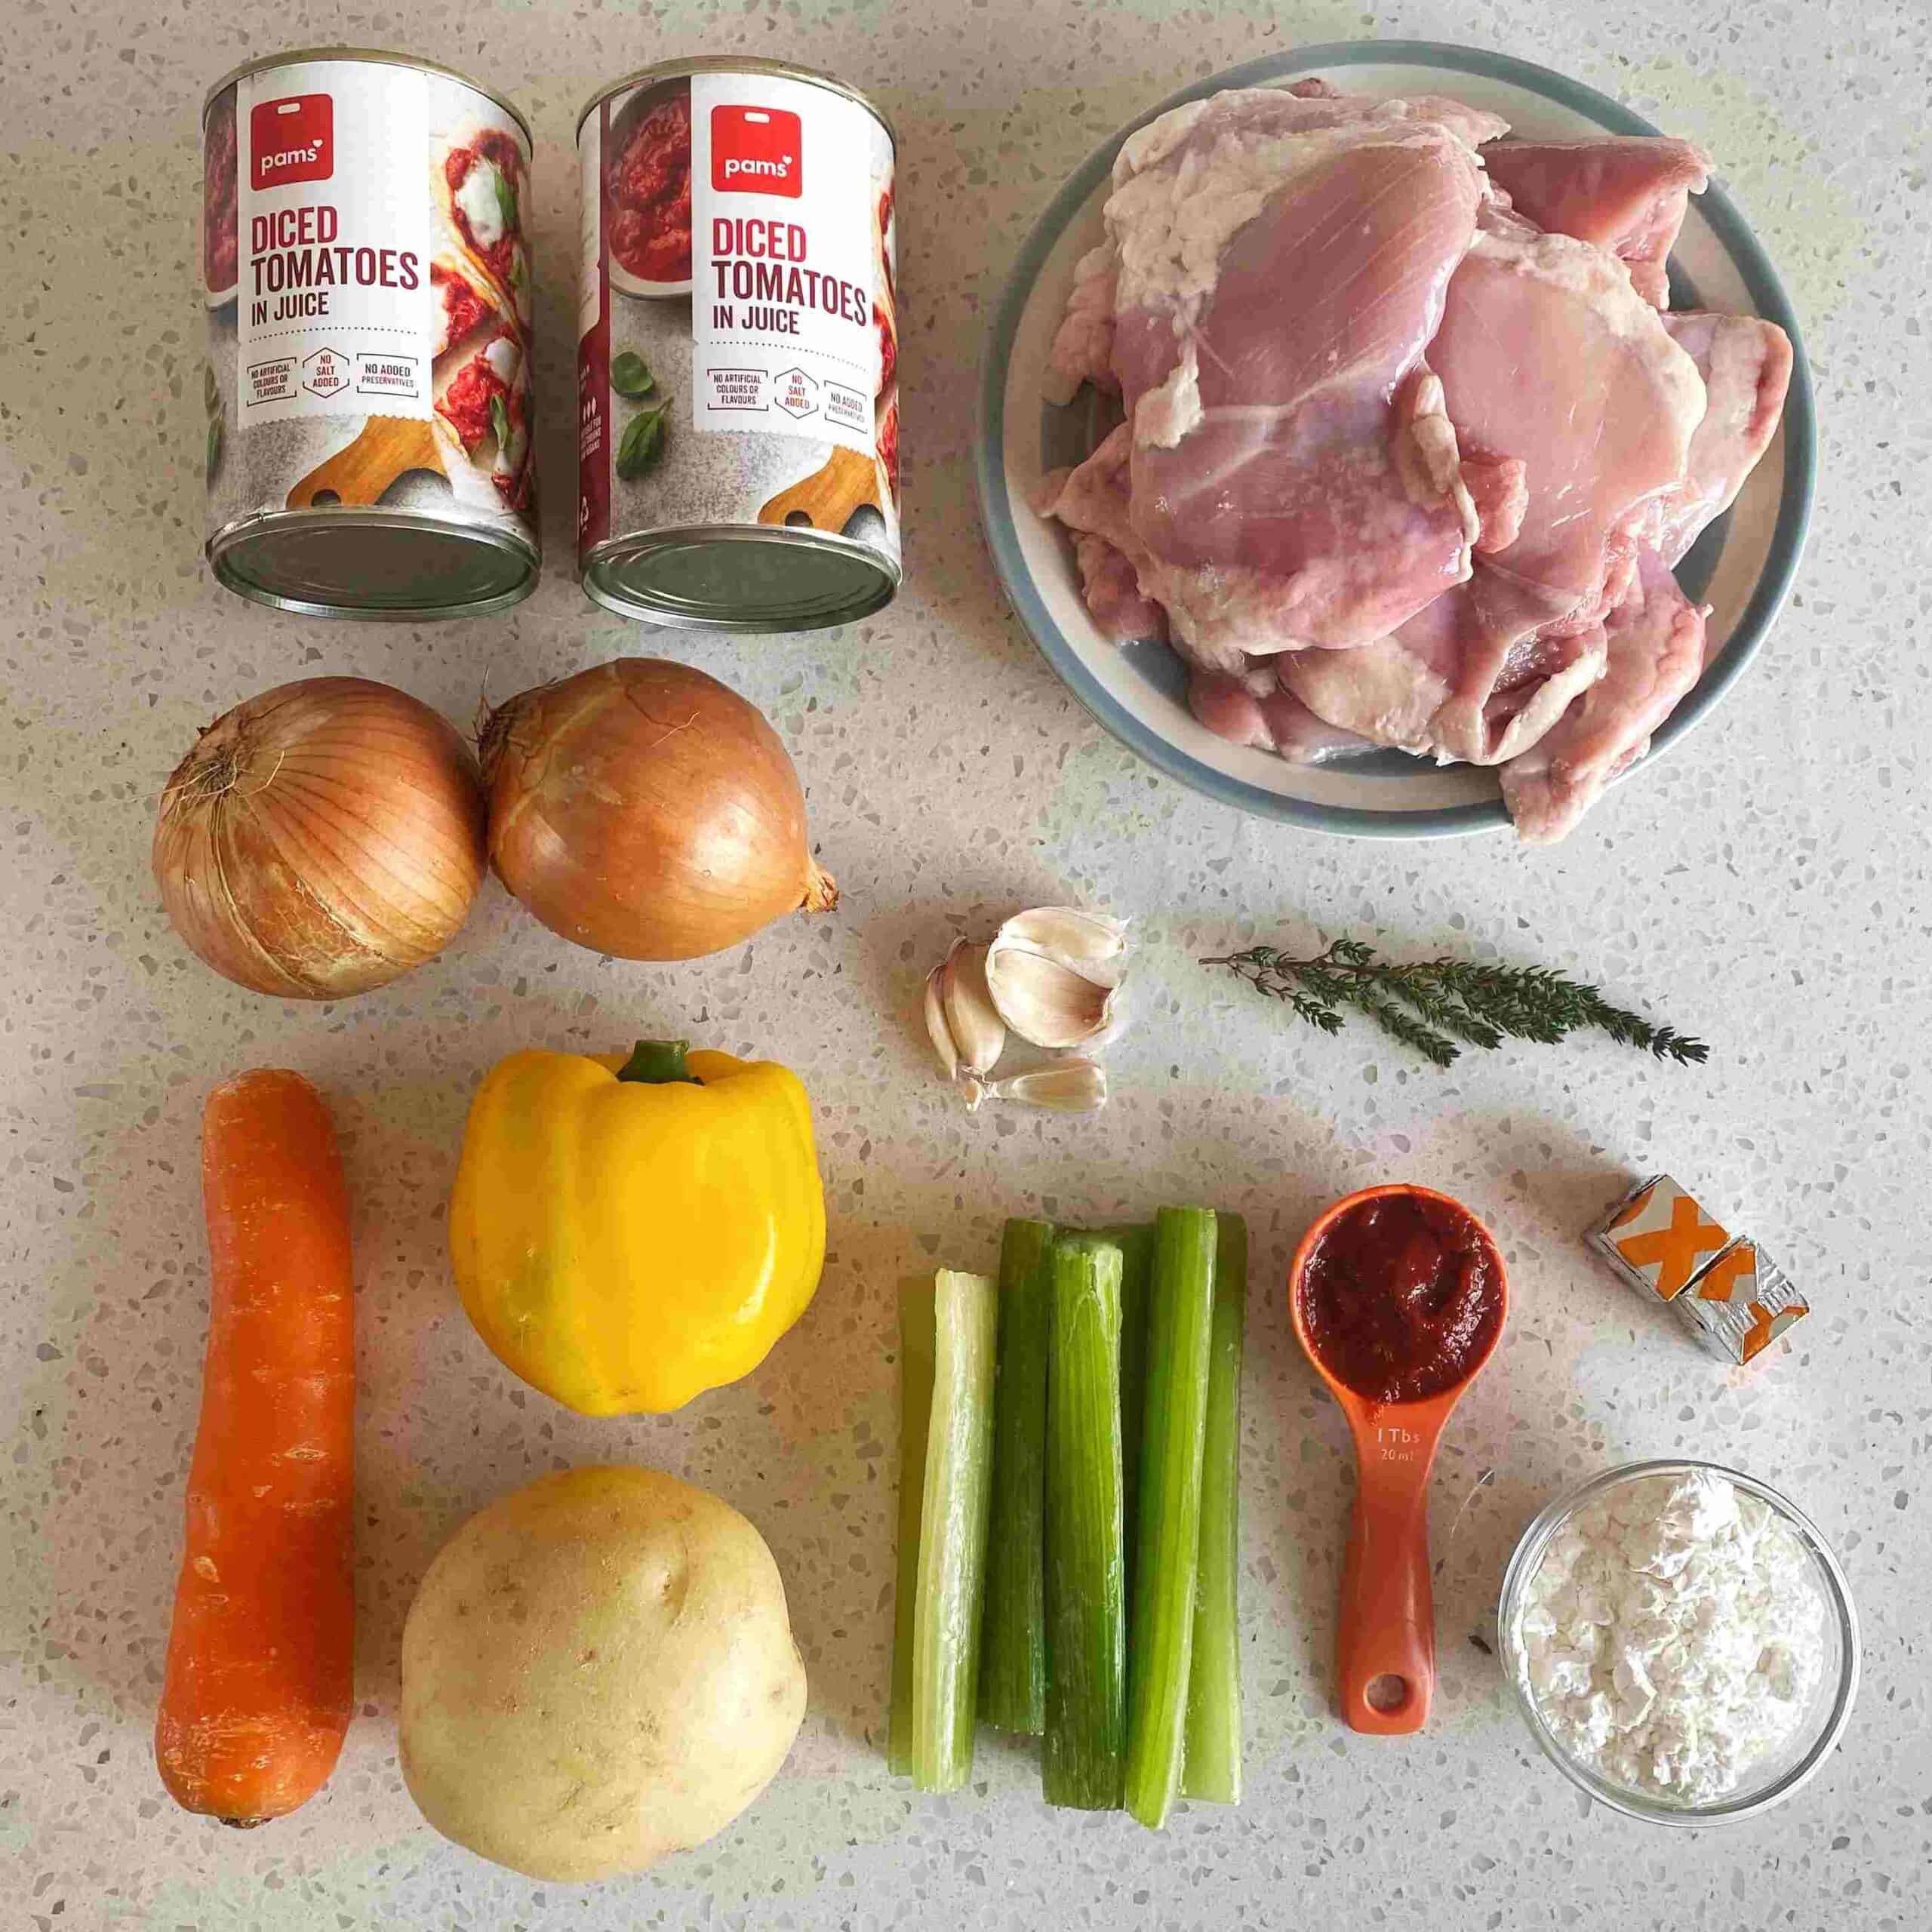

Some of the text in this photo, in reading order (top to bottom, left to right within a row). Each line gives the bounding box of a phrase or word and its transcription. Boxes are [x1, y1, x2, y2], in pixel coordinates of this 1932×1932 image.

[260, 146, 318, 176] pams
[724, 158, 788, 178] pams
[251, 206, 338, 255] DICED
[712, 217, 807, 263] DICED
[251, 248, 419, 296] TOMATOES
[711, 260, 867, 327] TOMATOES
[251, 292, 330, 327] IN JUICE
[713, 305, 800, 335] IN JUICE
[319, 355, 331, 365] NO
[315, 365, 335, 376] SALT
[365, 363, 411, 377] NO ADDED
[312, 377, 339, 388] ADDED
[361, 376, 414, 388] PRESERVATIVES
[713, 374, 761, 384] NO ARTIFICIAL
[792, 374, 803, 385] NO
[716, 384, 759, 395] COLOURS OR
[788, 385, 806, 397] SALT
[721, 395, 757, 405] FLAVOURS
[785, 396, 810, 409] ADDED
[830, 392, 841, 404] NO
[1388, 1428, 1421, 1443] Tbs
